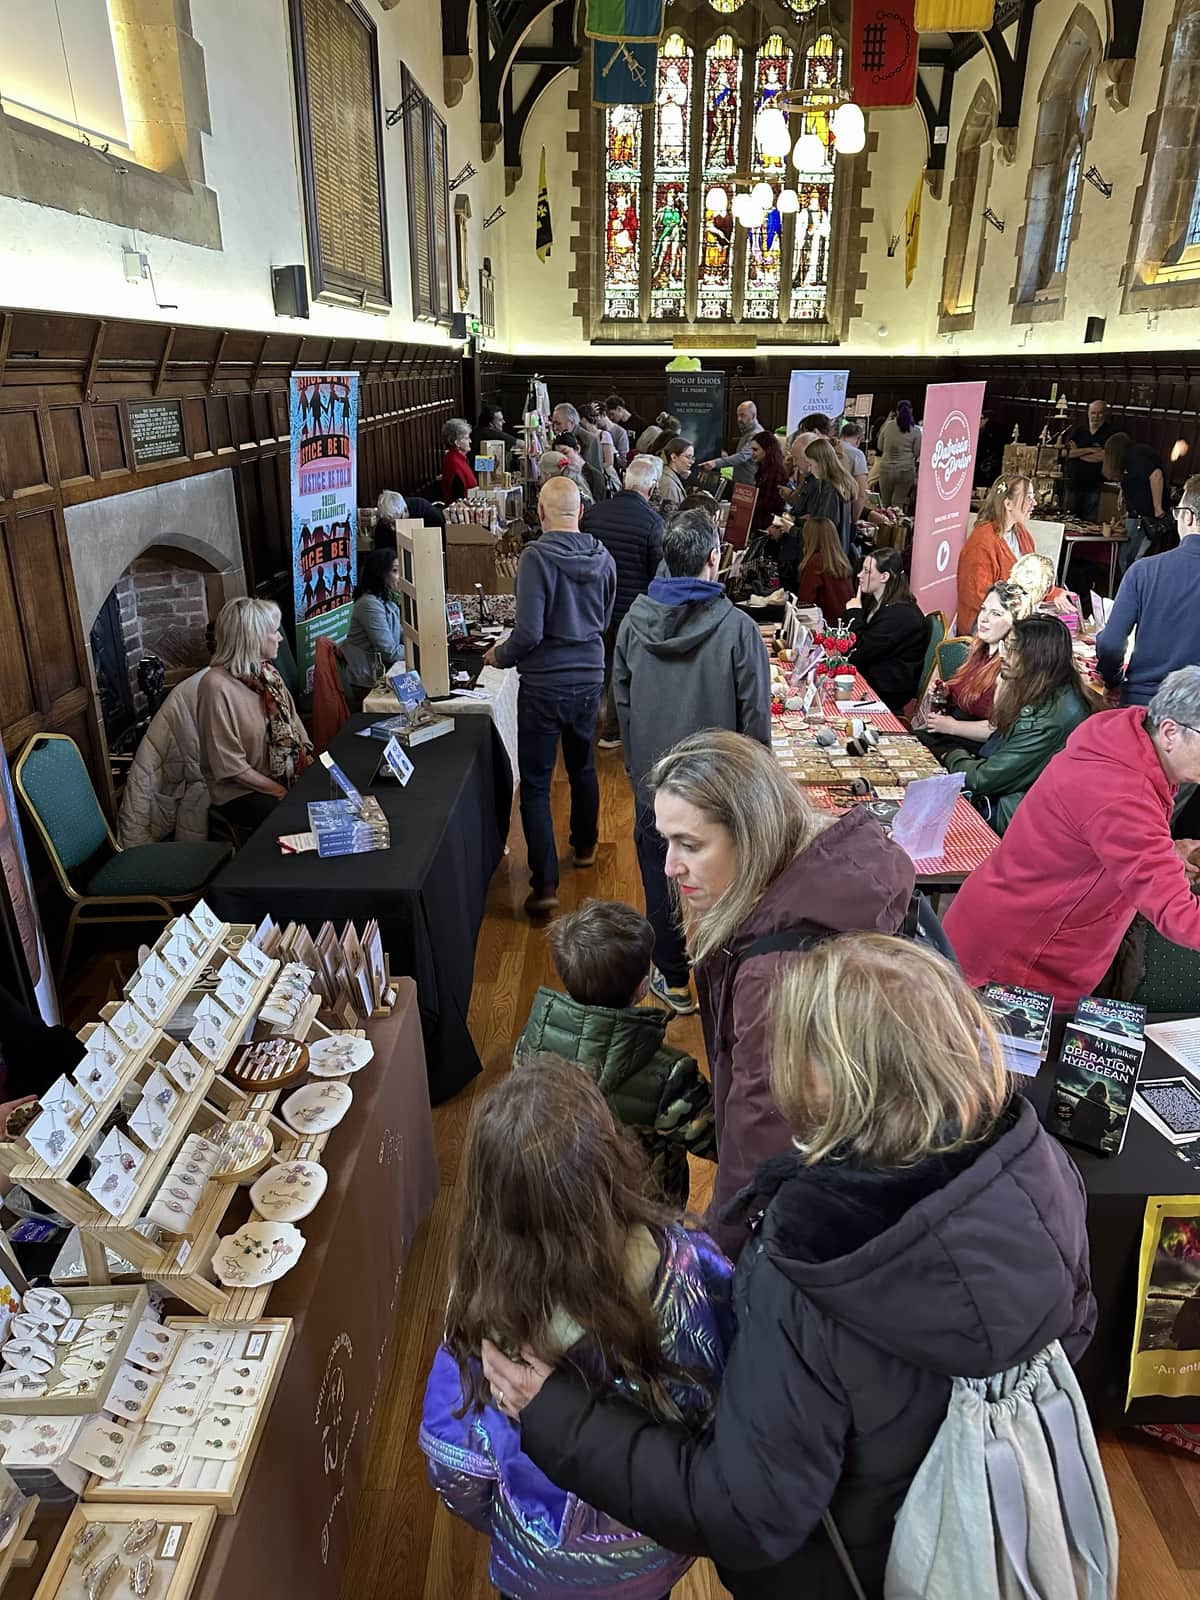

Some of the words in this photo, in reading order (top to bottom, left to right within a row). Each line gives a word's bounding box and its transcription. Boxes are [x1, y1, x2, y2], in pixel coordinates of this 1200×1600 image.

[669, 376, 686, 385] SONG
[697, 376, 721, 385] ECHOES
[299, 471, 326, 494] JUSTICE
[328, 470, 336, 488] BE
[336, 467, 351, 488] TOLD
[986, 993, 1045, 1012] HYPOGEAN
[988, 988, 1049, 1009] OPERATION
[1120, 1003, 1145, 1012] Walker
[1080, 1007, 1140, 1024] HYPOGEAN
[1081, 1002, 1144, 1020] OPERATION
[1064, 1044, 1136, 1076] OPERATION
[1095, 1039, 1104, 1049] M
[1104, 1041, 1109, 1053] J
[1110, 1044, 1139, 1061] Walker
[1062, 1053, 1130, 1084] HYPOGEAN
